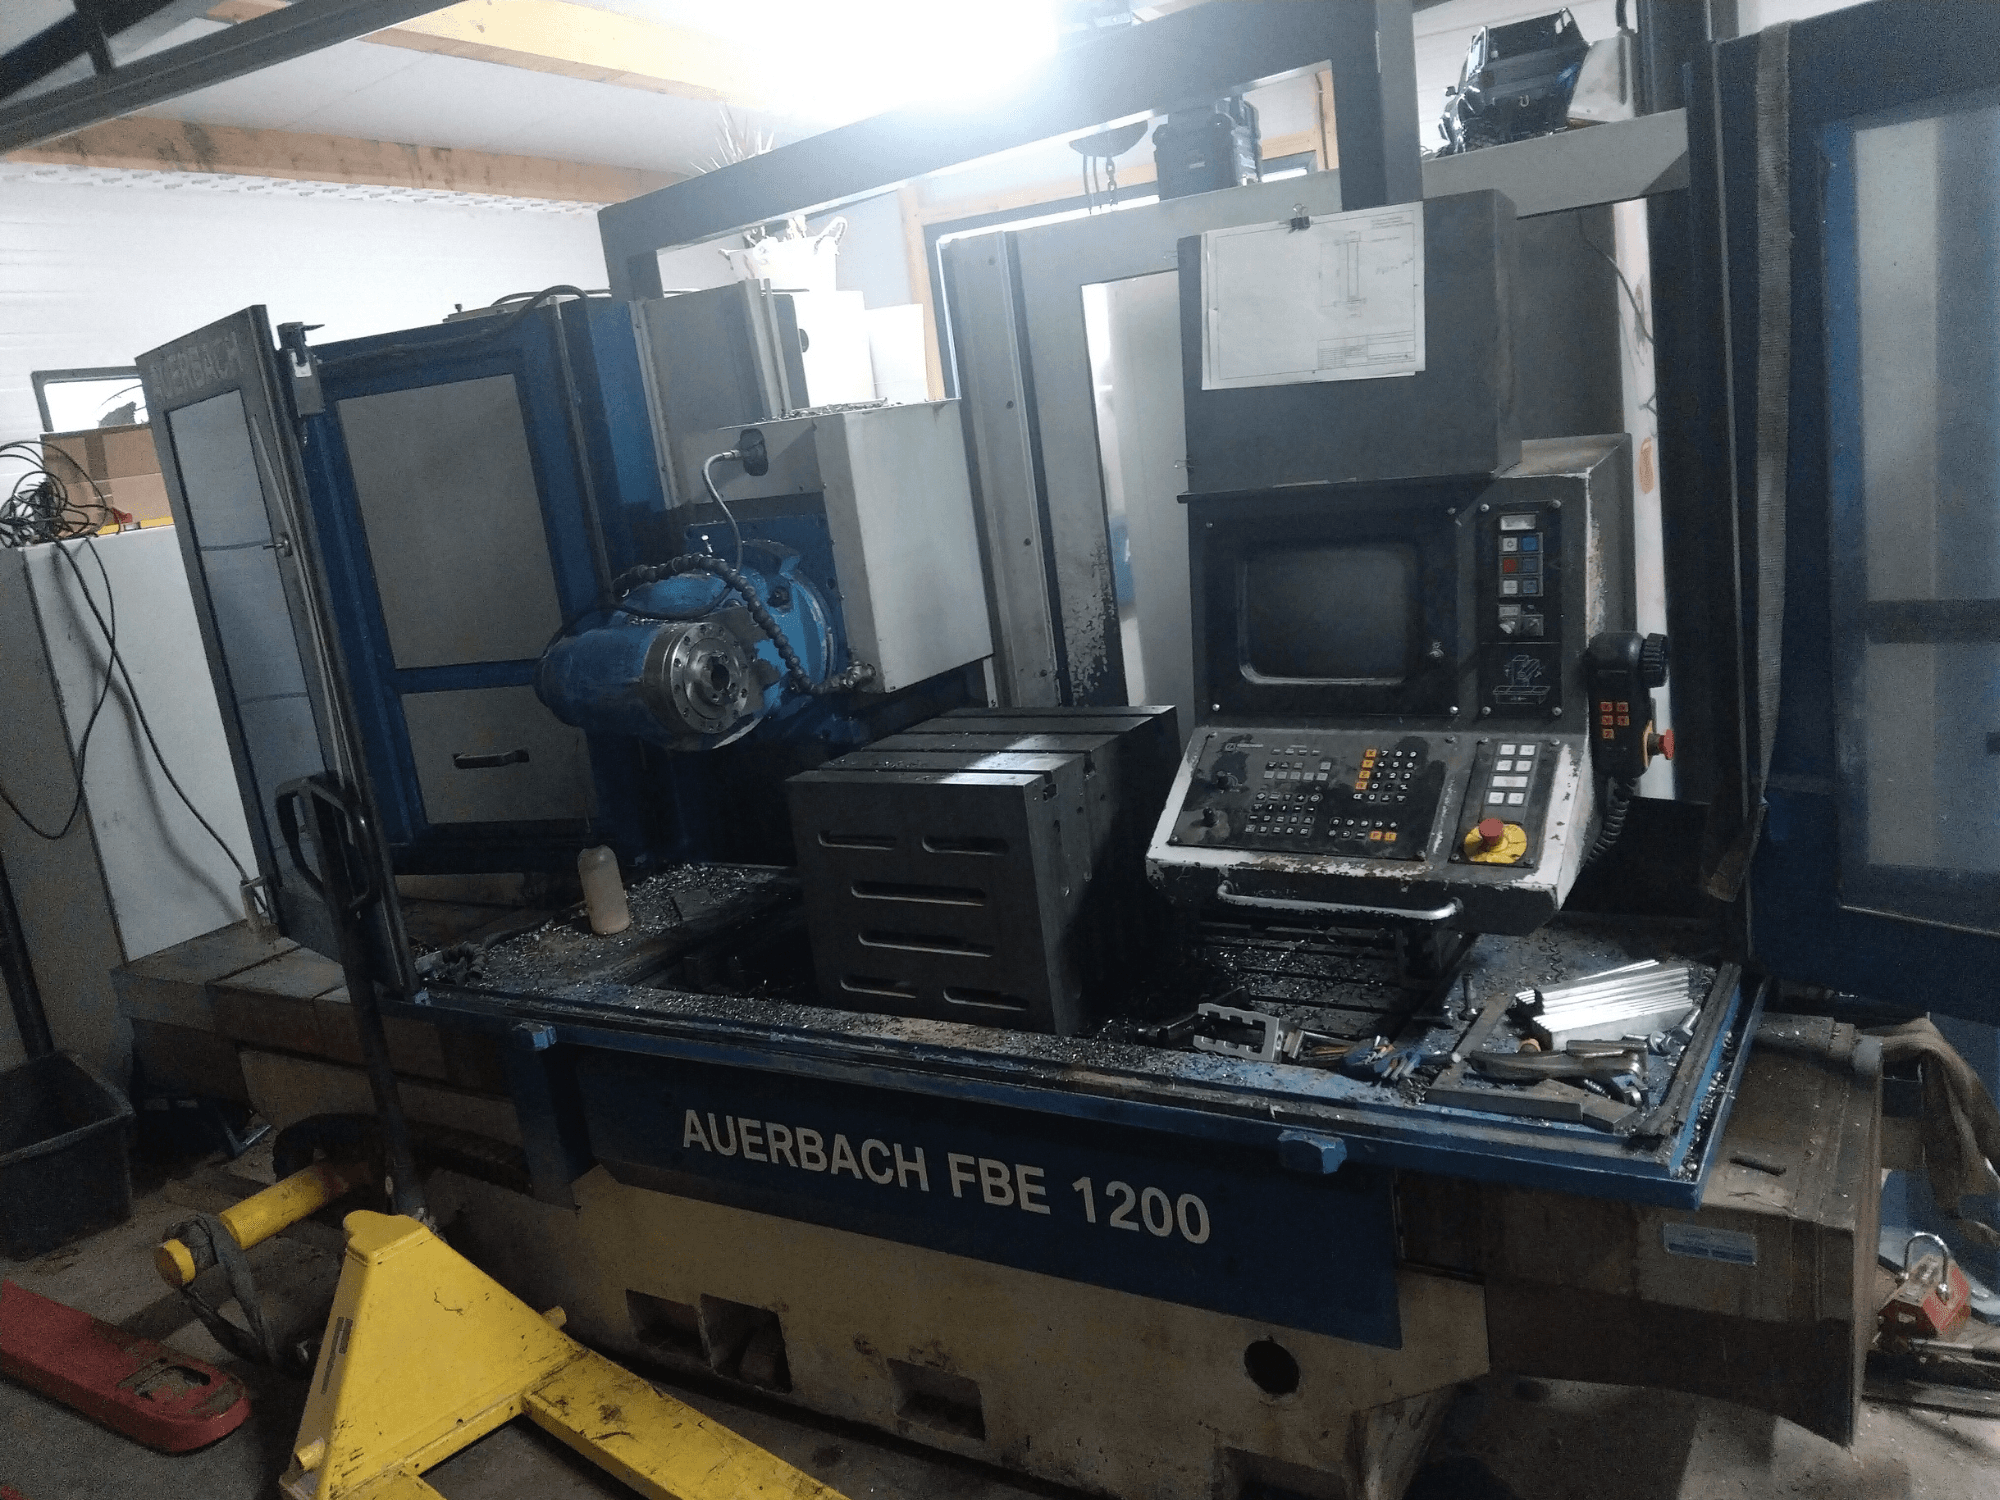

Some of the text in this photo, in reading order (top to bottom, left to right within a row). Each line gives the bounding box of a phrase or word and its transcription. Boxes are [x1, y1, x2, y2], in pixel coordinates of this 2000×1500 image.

[683, 1109, 1211, 1245] AUERBACH FBE 1200
